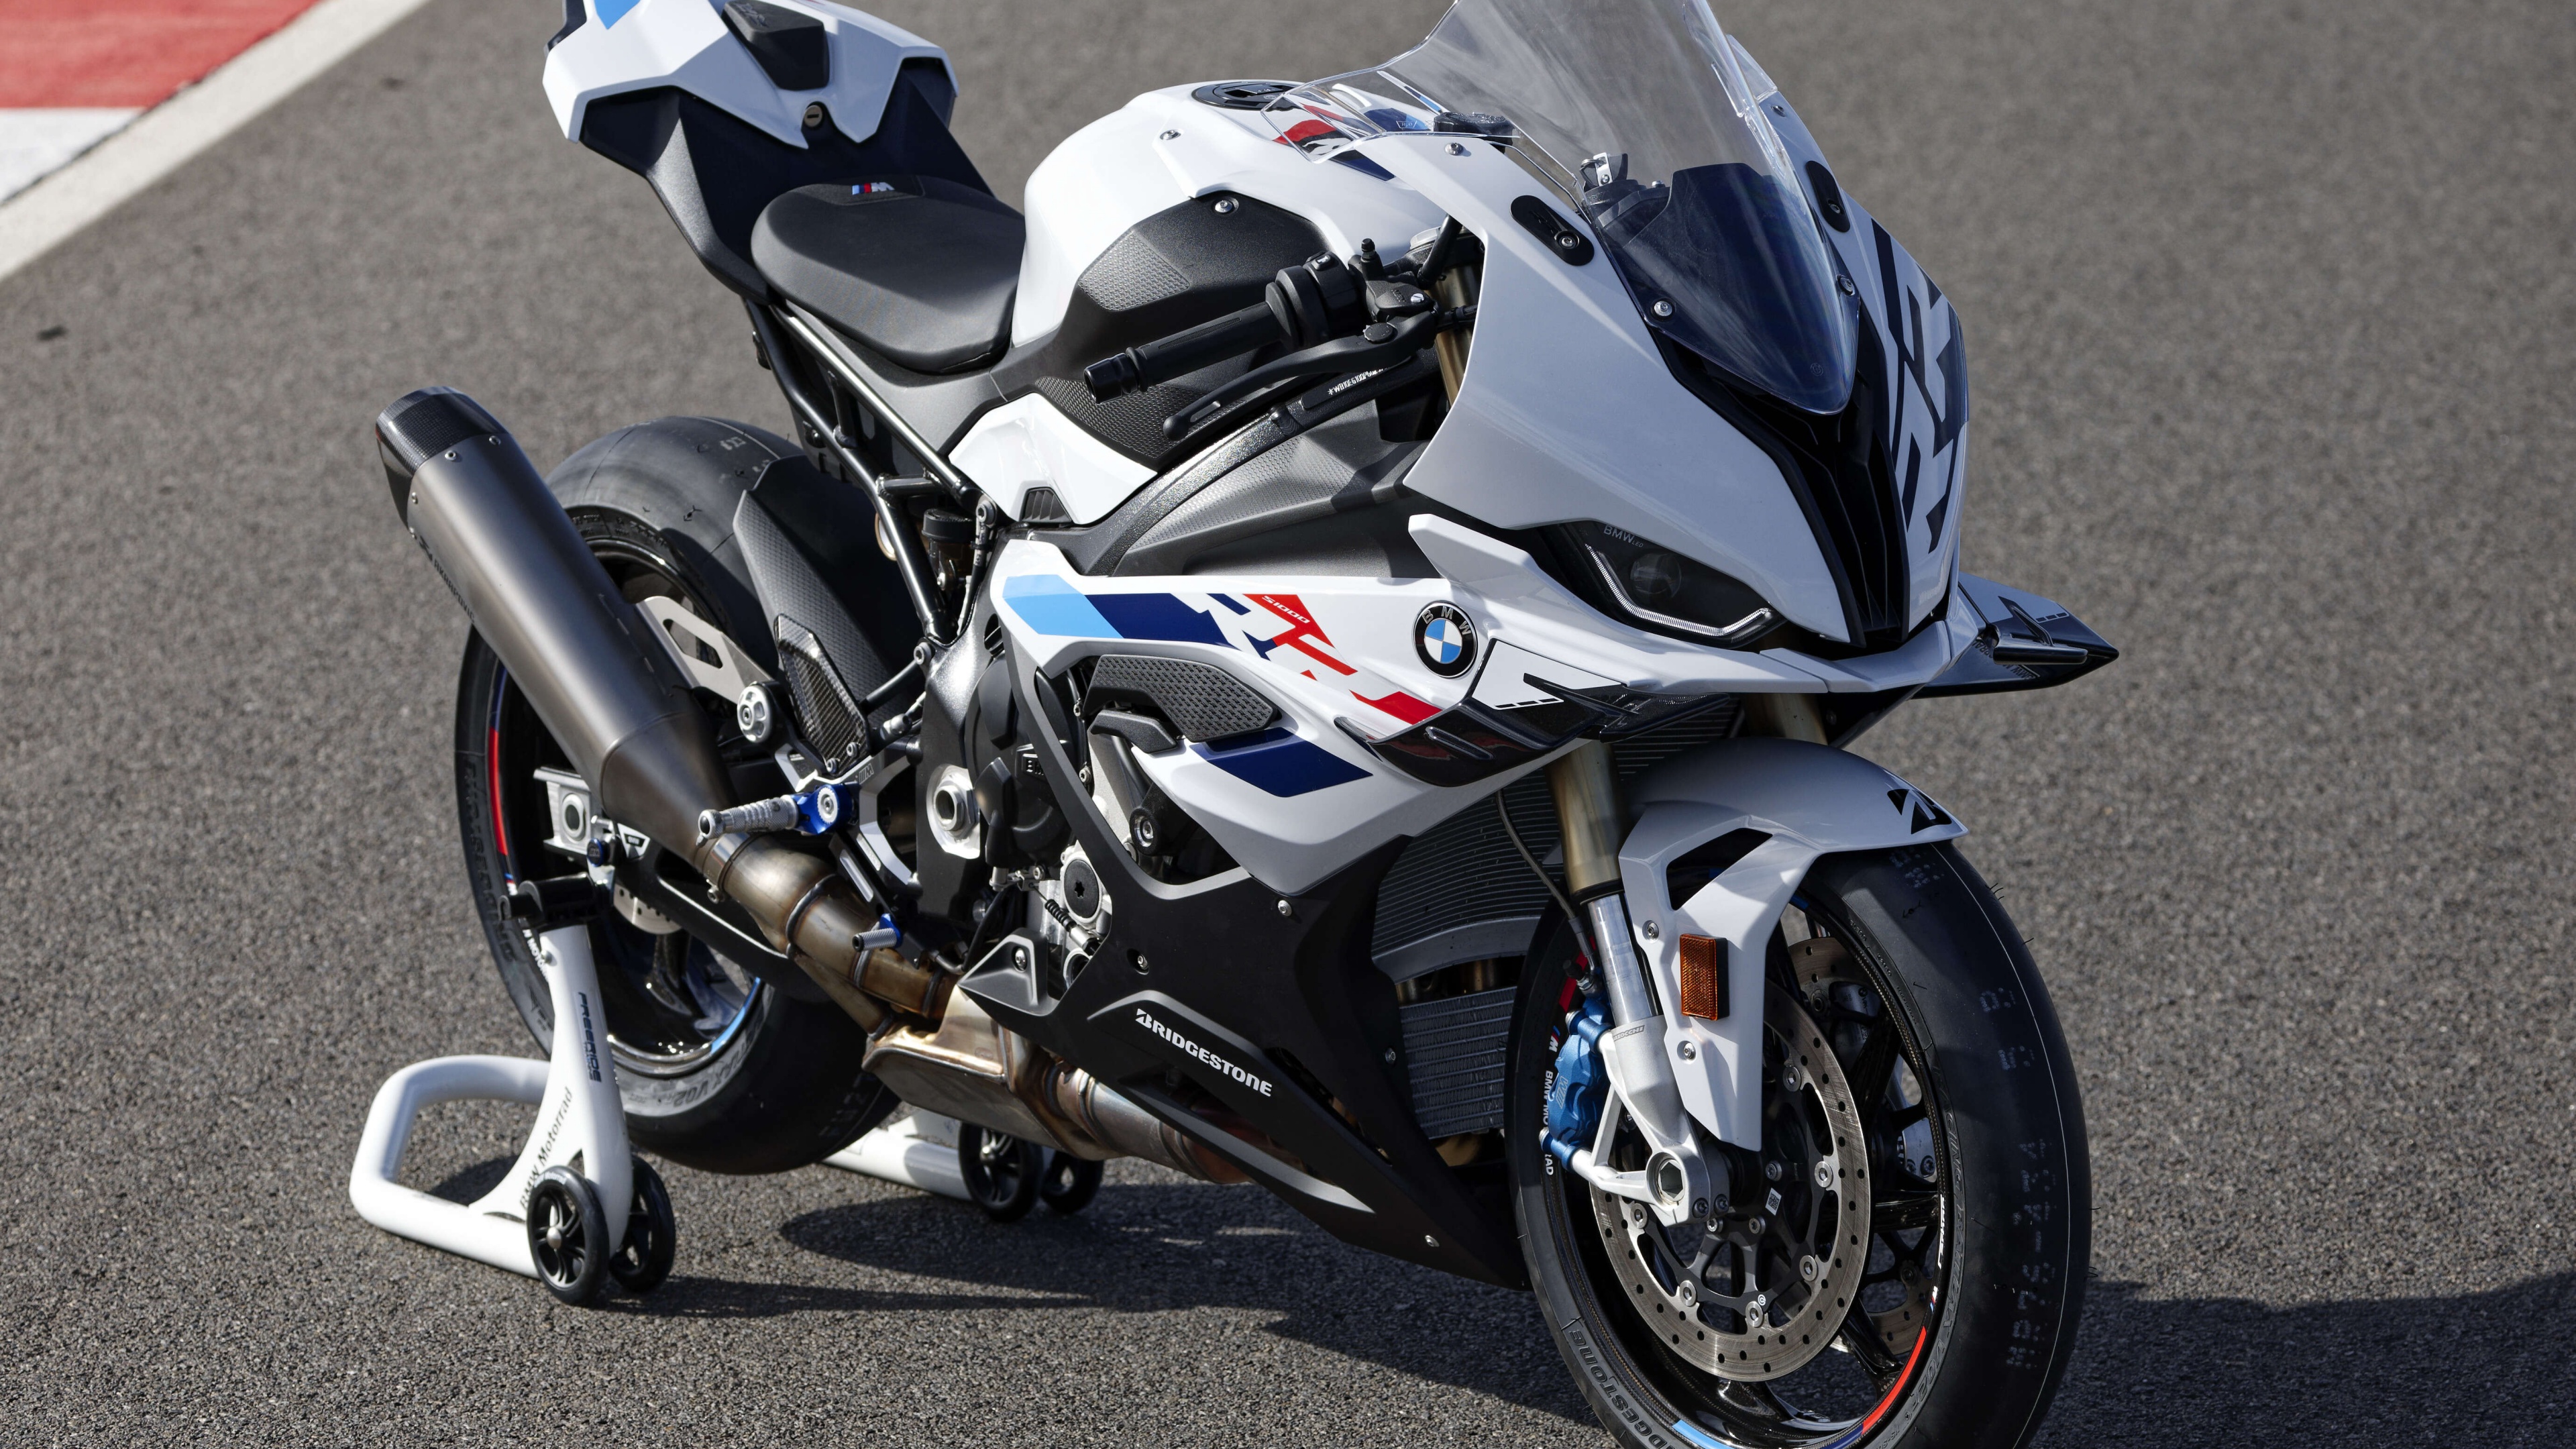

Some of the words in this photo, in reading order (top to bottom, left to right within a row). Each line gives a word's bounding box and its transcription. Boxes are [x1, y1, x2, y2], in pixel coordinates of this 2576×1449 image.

[1603, 525, 1635, 543] BMW
[1631, 540, 1644, 548] LED
[1262, 595, 1310, 624] S1000
[1421, 606, 1472, 636] BMW
[578, 991, 602, 1083] FREERIDE
[1135, 1008, 1273, 1097] BRIDGESTONE
[538, 1085, 573, 1167] Motorrad
